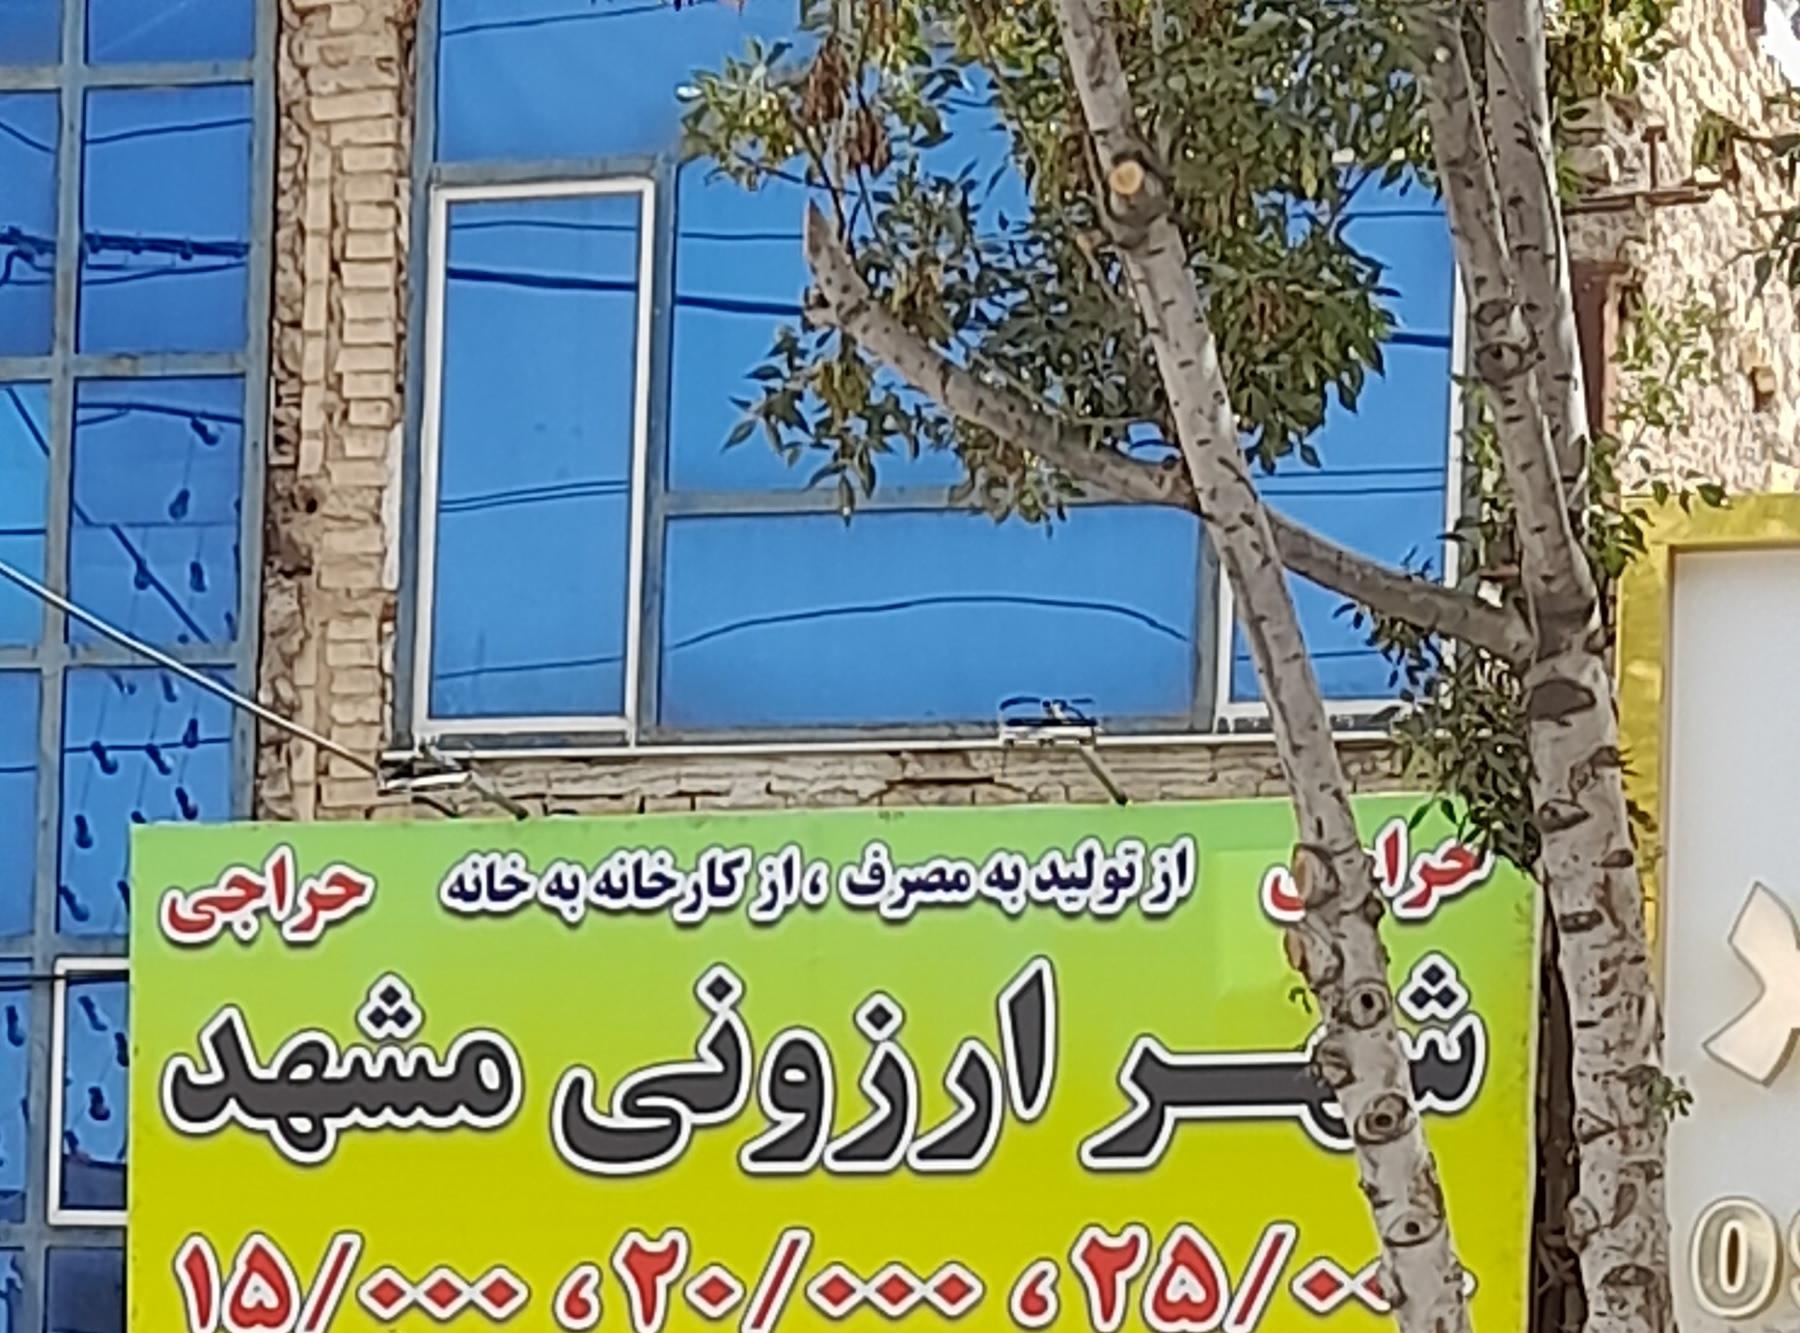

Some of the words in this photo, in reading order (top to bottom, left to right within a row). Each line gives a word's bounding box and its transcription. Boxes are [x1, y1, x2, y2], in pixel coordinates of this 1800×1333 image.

[165, 850, 370, 937] حراجی
[445, 854, 533, 904] خانه
[542, 864, 583, 916] به
[590, 851, 748, 916] کارخانه
[750, 850, 797, 915] از
[843, 847, 973, 911] مصرف
[982, 852, 1023, 906] به
[1031, 845, 1141, 908] تولید
[1146, 842, 1190, 907] از
[167, 981, 517, 1154] مشهد
[559, 962, 1050, 1165] ارزونی
[178, 1238, 523, 1333] ۱۵/۰۰۰
[621, 1235, 979, 1333] ۲۰/۰۰۰
